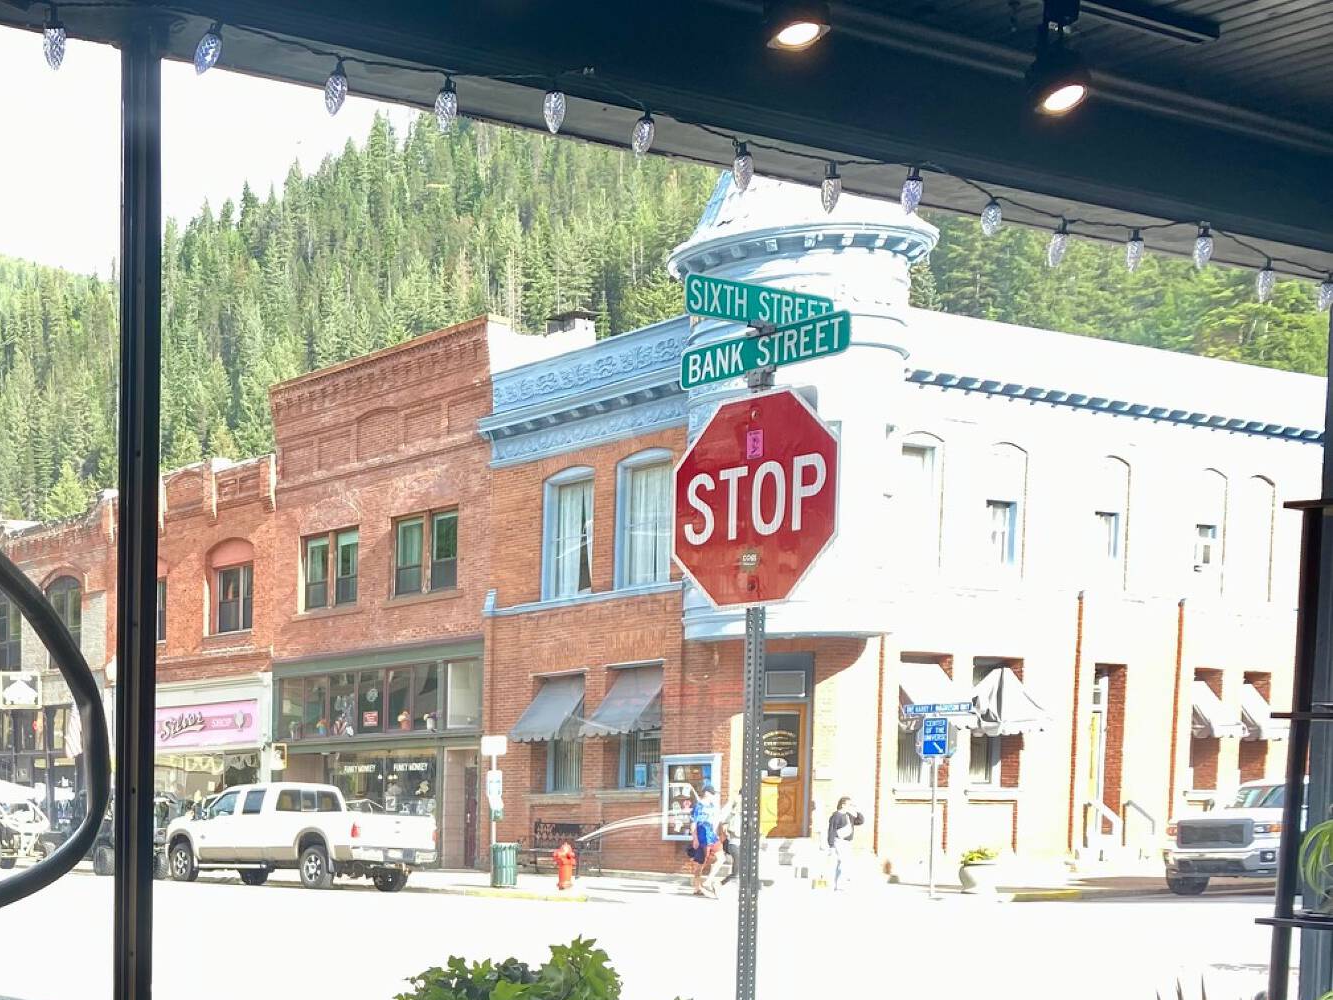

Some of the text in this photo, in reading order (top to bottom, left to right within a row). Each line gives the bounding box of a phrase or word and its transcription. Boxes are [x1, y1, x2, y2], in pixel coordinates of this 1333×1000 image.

[689, 278, 748, 319] SIXTH
[688, 316, 844, 384] BANK STREET
[684, 452, 827, 546] STOP
